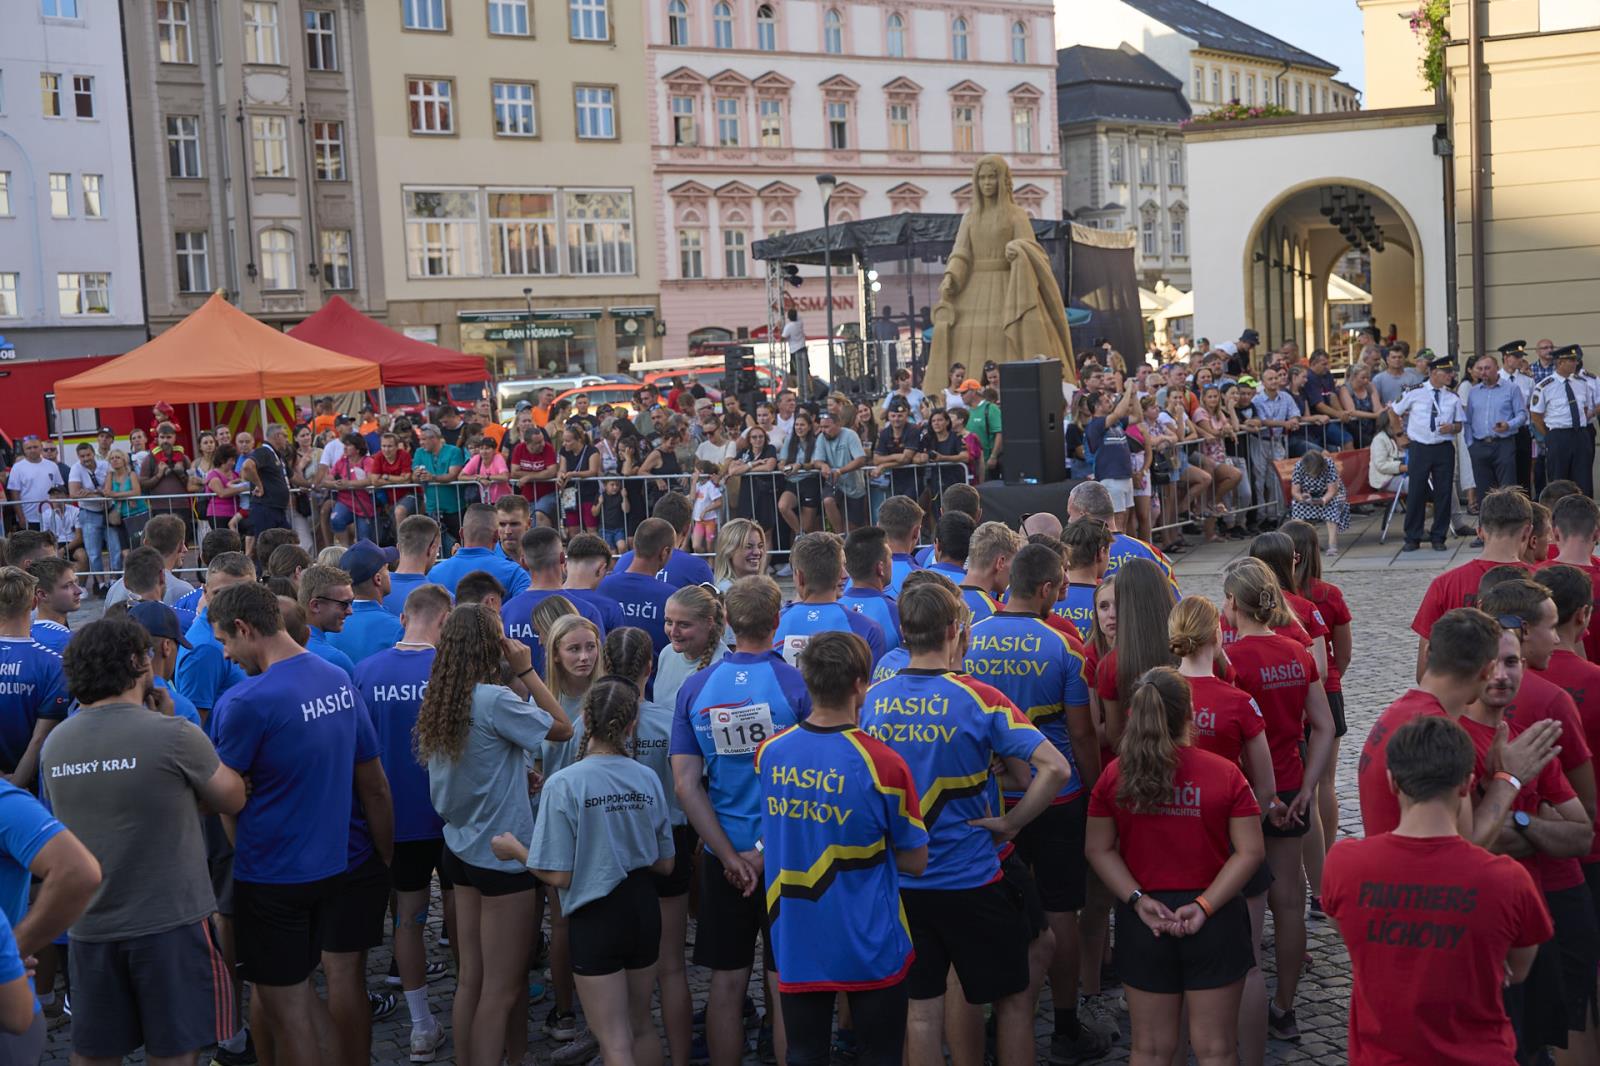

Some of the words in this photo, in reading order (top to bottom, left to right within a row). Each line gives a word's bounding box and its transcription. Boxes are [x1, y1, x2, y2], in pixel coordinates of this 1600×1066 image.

[502, 328, 525, 339] GRAN
[0, 350, 16, 359] OB
[1107, 552, 1137, 570] SIČ
[618, 601, 657, 619] SIČI
[1050, 607, 1093, 620] HASI
[971, 633, 1042, 652] HASIČI
[0, 660, 22, 676] RNÍ
[964, 659, 1049, 676] BOZKOV
[1260, 660, 1306, 683] HASIČI
[0, 682, 35, 696] OLUPY
[374, 680, 430, 702] HASIČ
[301, 685, 355, 722] HASIČI
[874, 693, 951, 716] HASIČI
[721, 723, 767, 746] 118
[868, 723, 958, 743] BOZKOV
[51, 760, 99, 778] ZLÍNSKÝ
[102, 757, 136, 771] KRAJ
[771, 765, 845, 794] HASIČI
[585, 795, 606, 808] SDH
[1175, 781, 1201, 806] IČI
[767, 796, 853, 825] BOZKOV
[1358, 880, 1478, 913] PANTHERS
